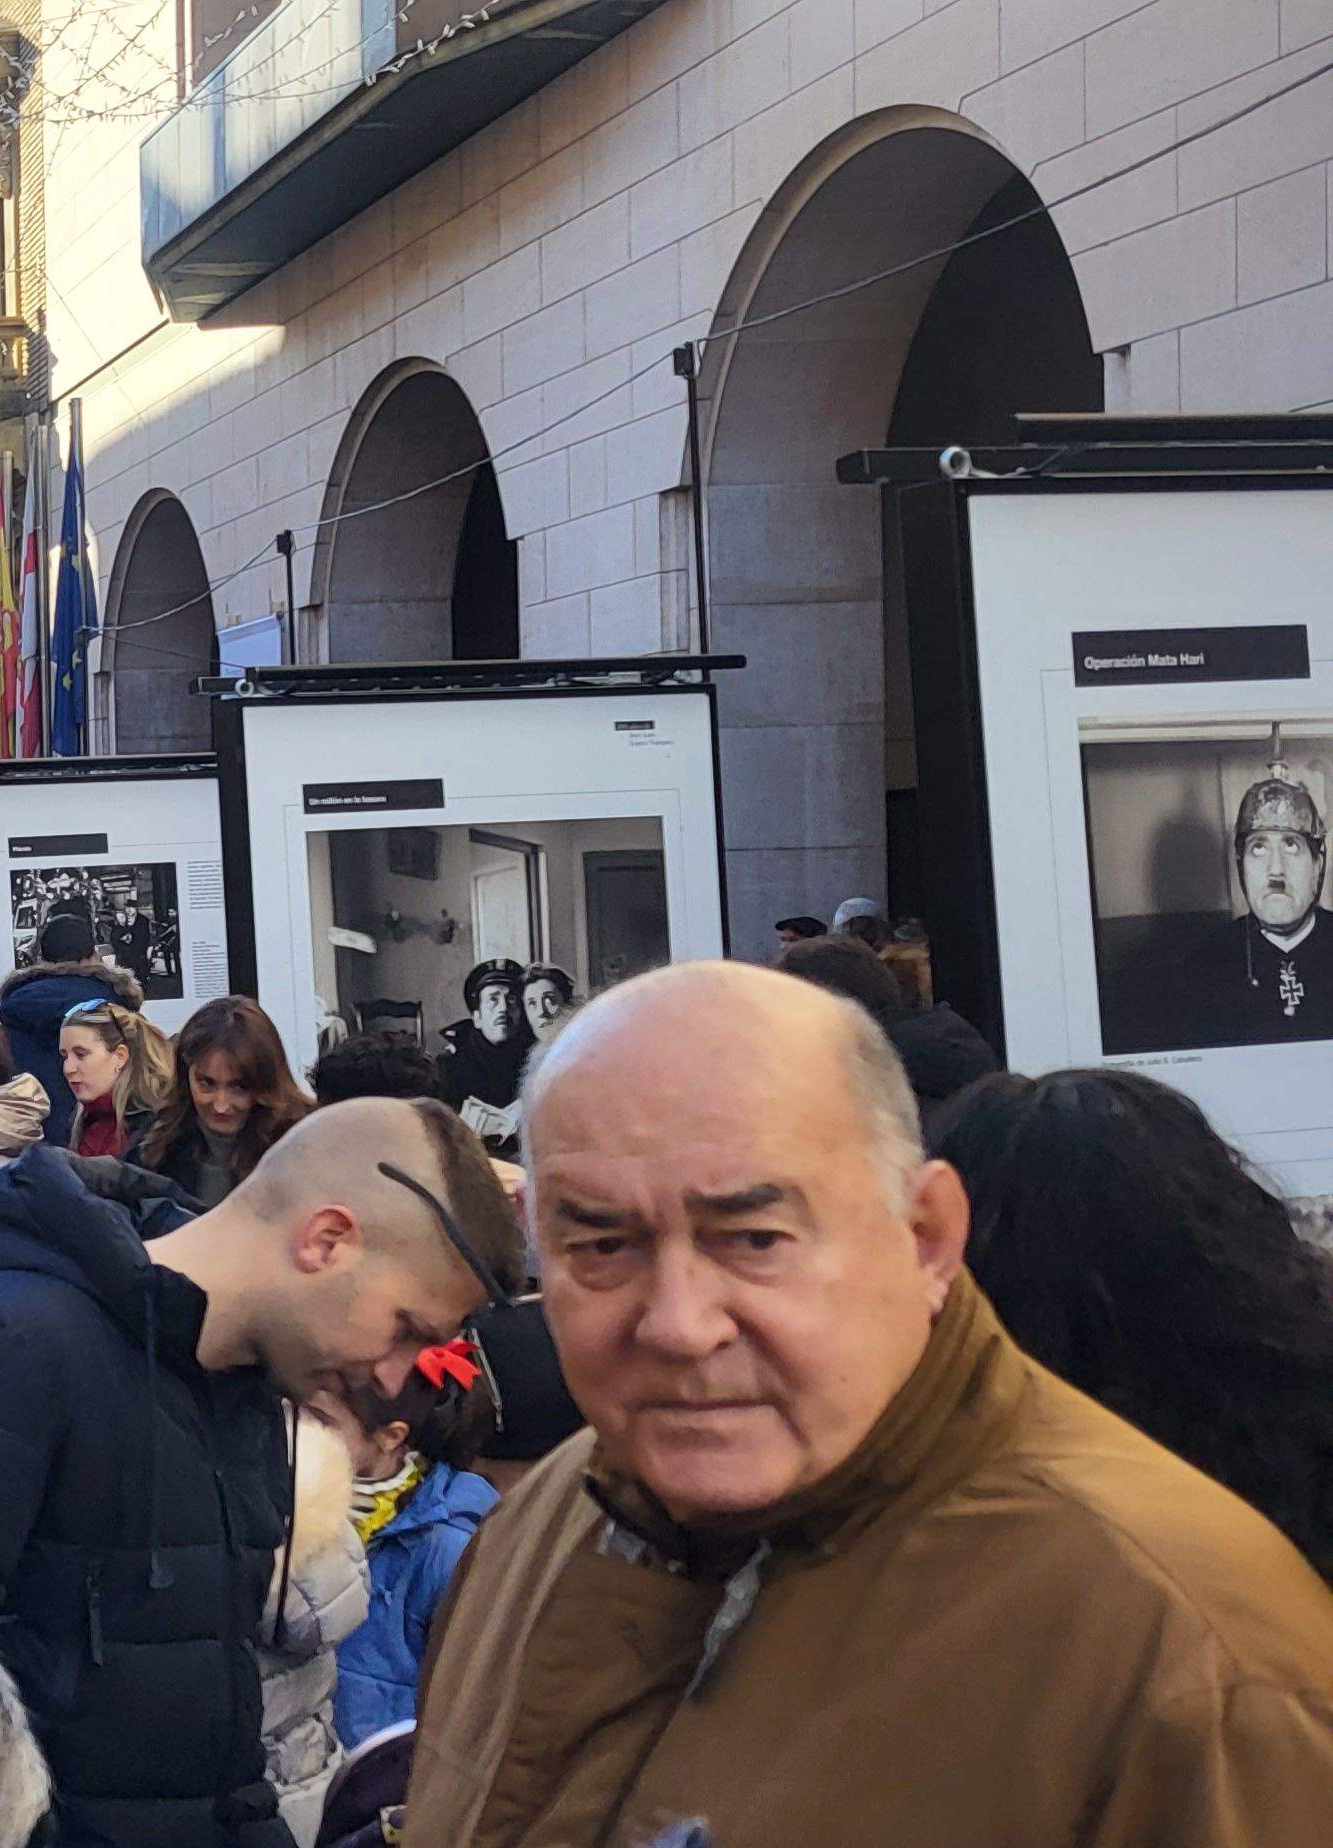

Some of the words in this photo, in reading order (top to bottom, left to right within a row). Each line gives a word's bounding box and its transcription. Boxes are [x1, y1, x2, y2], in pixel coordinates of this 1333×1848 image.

[1084, 654, 1145, 670] Operación
[1148, 655, 1178, 666] Mata
[1180, 652, 1205, 665] Hari
